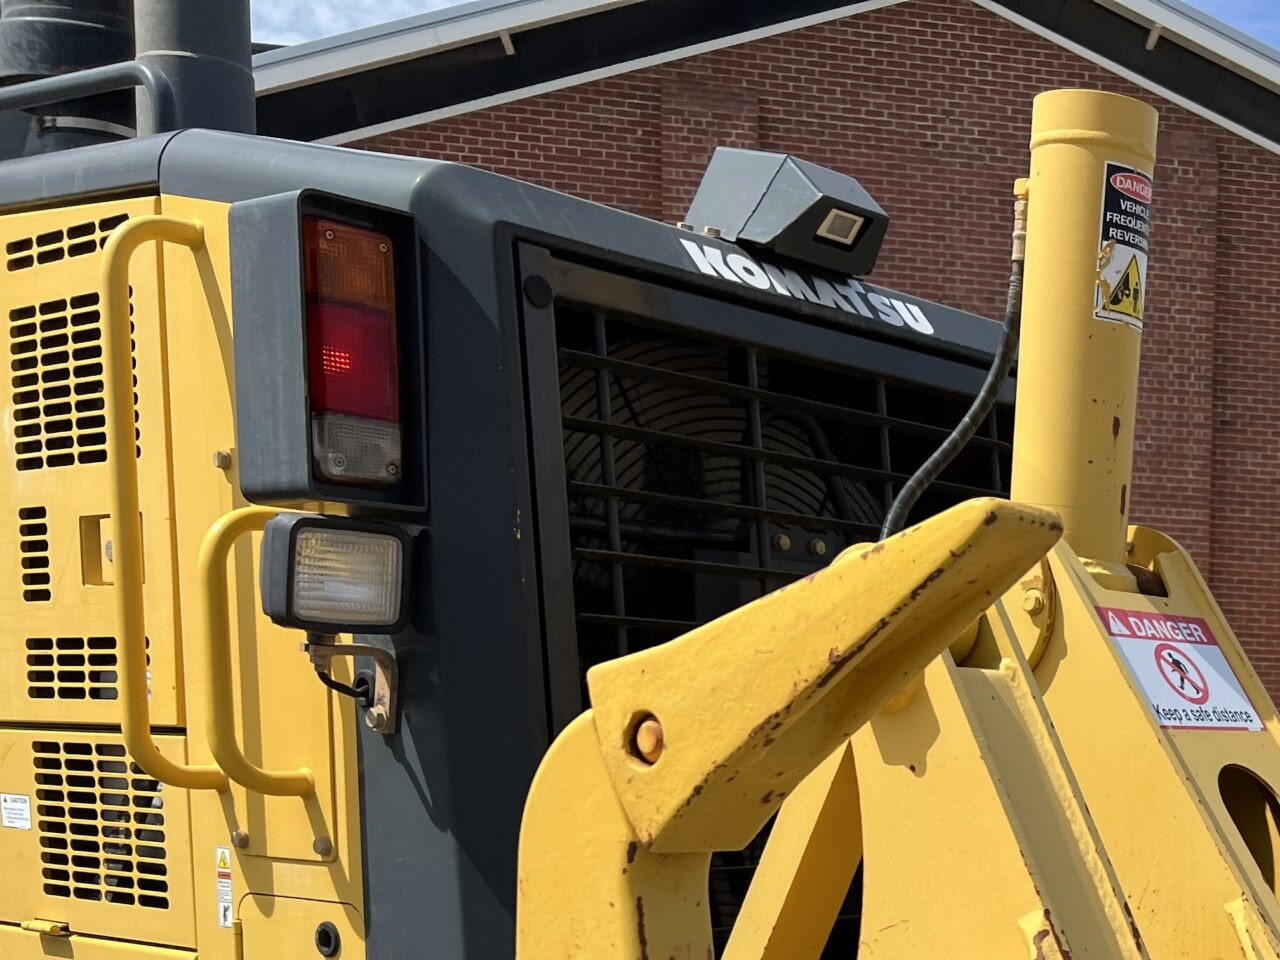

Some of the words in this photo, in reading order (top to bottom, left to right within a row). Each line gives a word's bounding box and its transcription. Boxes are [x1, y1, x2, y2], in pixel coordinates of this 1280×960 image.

[679, 238, 935, 335] KOMATSU
[1128, 617, 1208, 643] DANGER
[1152, 704, 1183, 724] Keep
[1184, 708, 1192, 722] a
[1191, 706, 1212, 722] safe
[1212, 705, 1253, 723] distance
